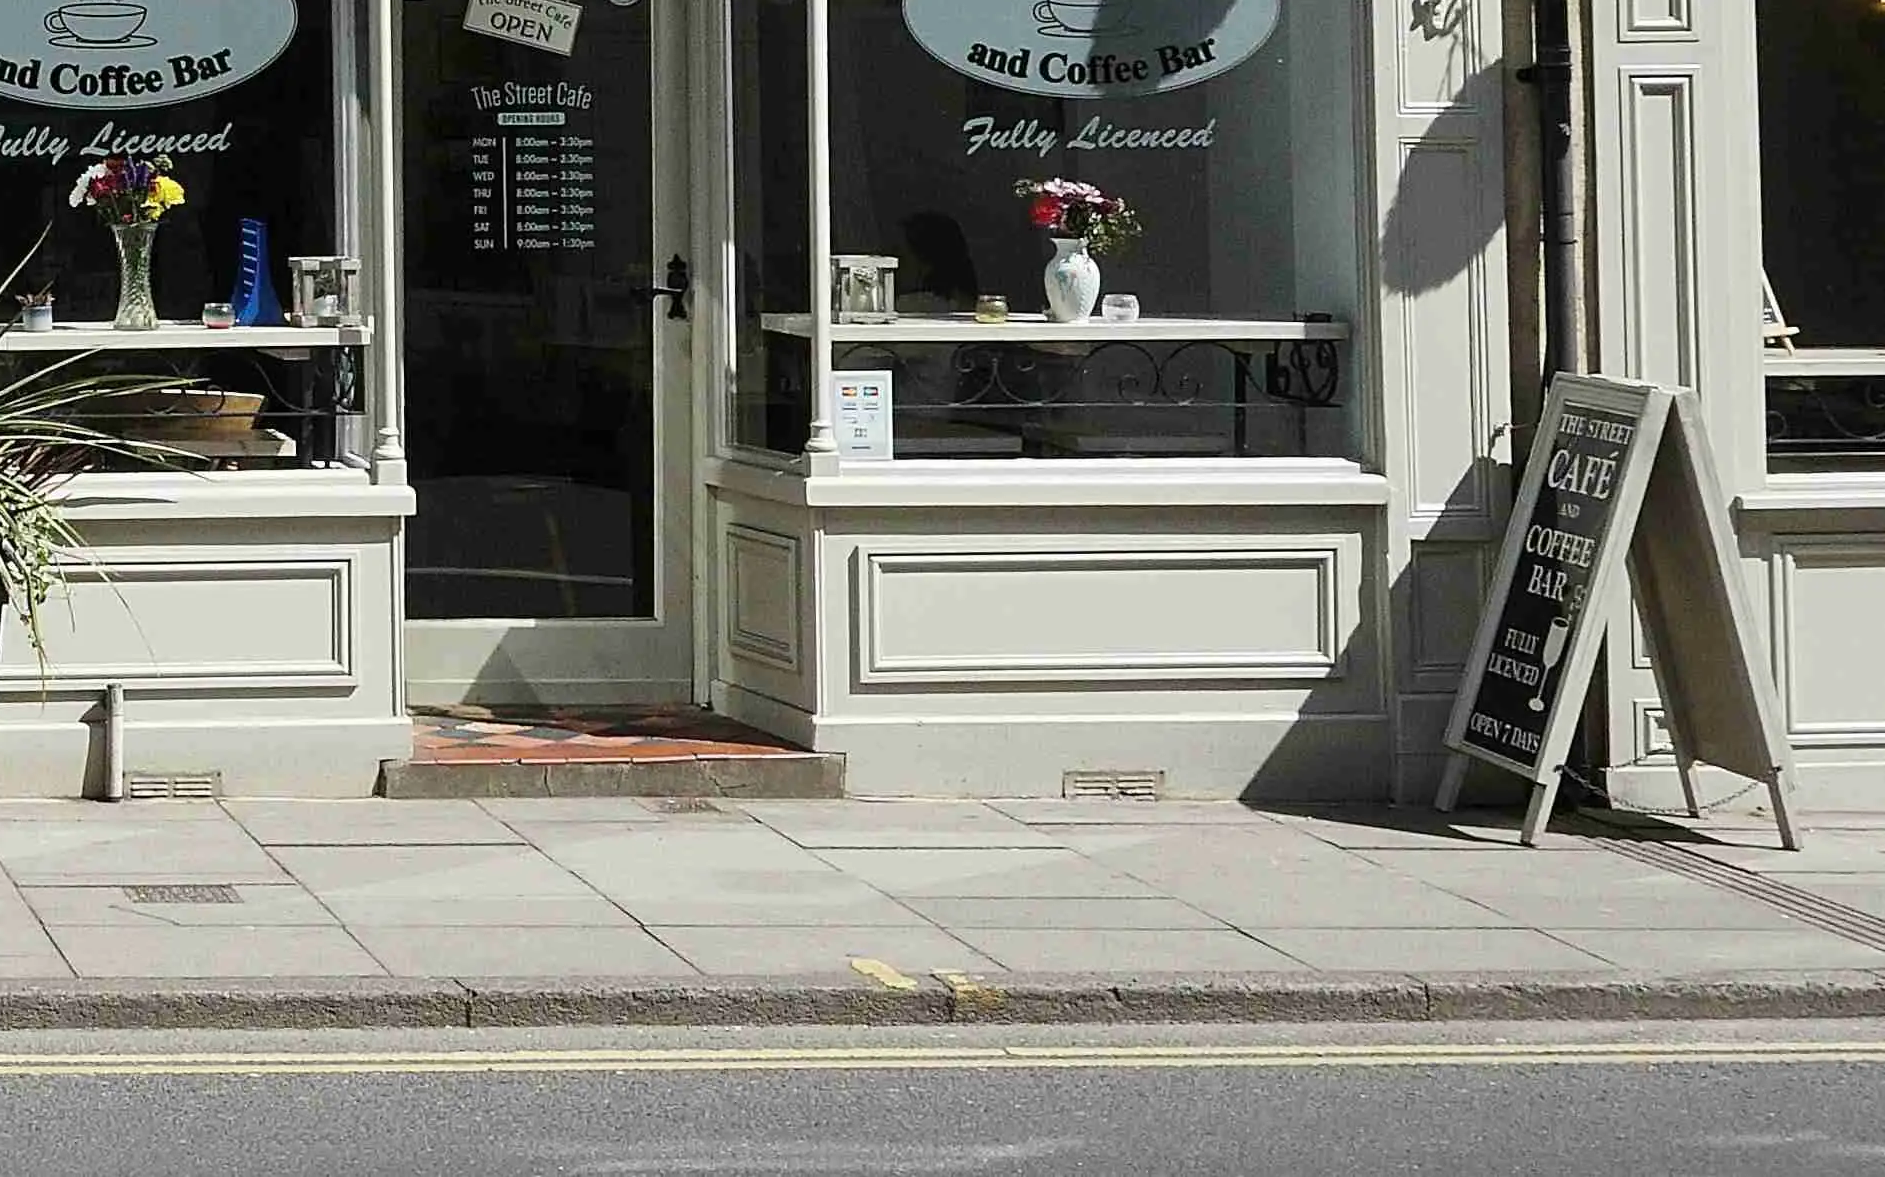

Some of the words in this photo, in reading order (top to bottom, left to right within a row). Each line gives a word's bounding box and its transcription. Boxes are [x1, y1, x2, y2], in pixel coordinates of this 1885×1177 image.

[490, 12, 553, 42] OPEN
[50, 62, 164, 96] Coffee
[168, 48, 233, 88] Bar
[967, 42, 1031, 78] and
[1039, 52, 1149, 85] Coffee
[1155, 37, 1217, 76] Bar
[470, 86, 501, 110] The
[504, 82, 552, 105] Street
[556, 82, 592, 110] Cafe
[79, 121, 234, 157] Licenced
[963, 116, 1058, 158] Fully
[1066, 115, 1217, 151] Licenced
[473, 188, 492, 198] THU
[474, 239, 494, 249] SUN
[1559, 413, 1587, 435] THE
[1586, 419, 1635, 445] STREET
[1548, 449, 1619, 500] CAFÉ
[1525, 524, 1596, 568] COFFEE
[1527, 564, 1568, 602] BAR
[1504, 628, 1539, 655] FULLY
[1488, 652, 1540, 686] LICENCED
[1470, 712, 1503, 739] OPEN
[1502, 724, 1513, 743] 7
[1513, 728, 1540, 755] DAYS
